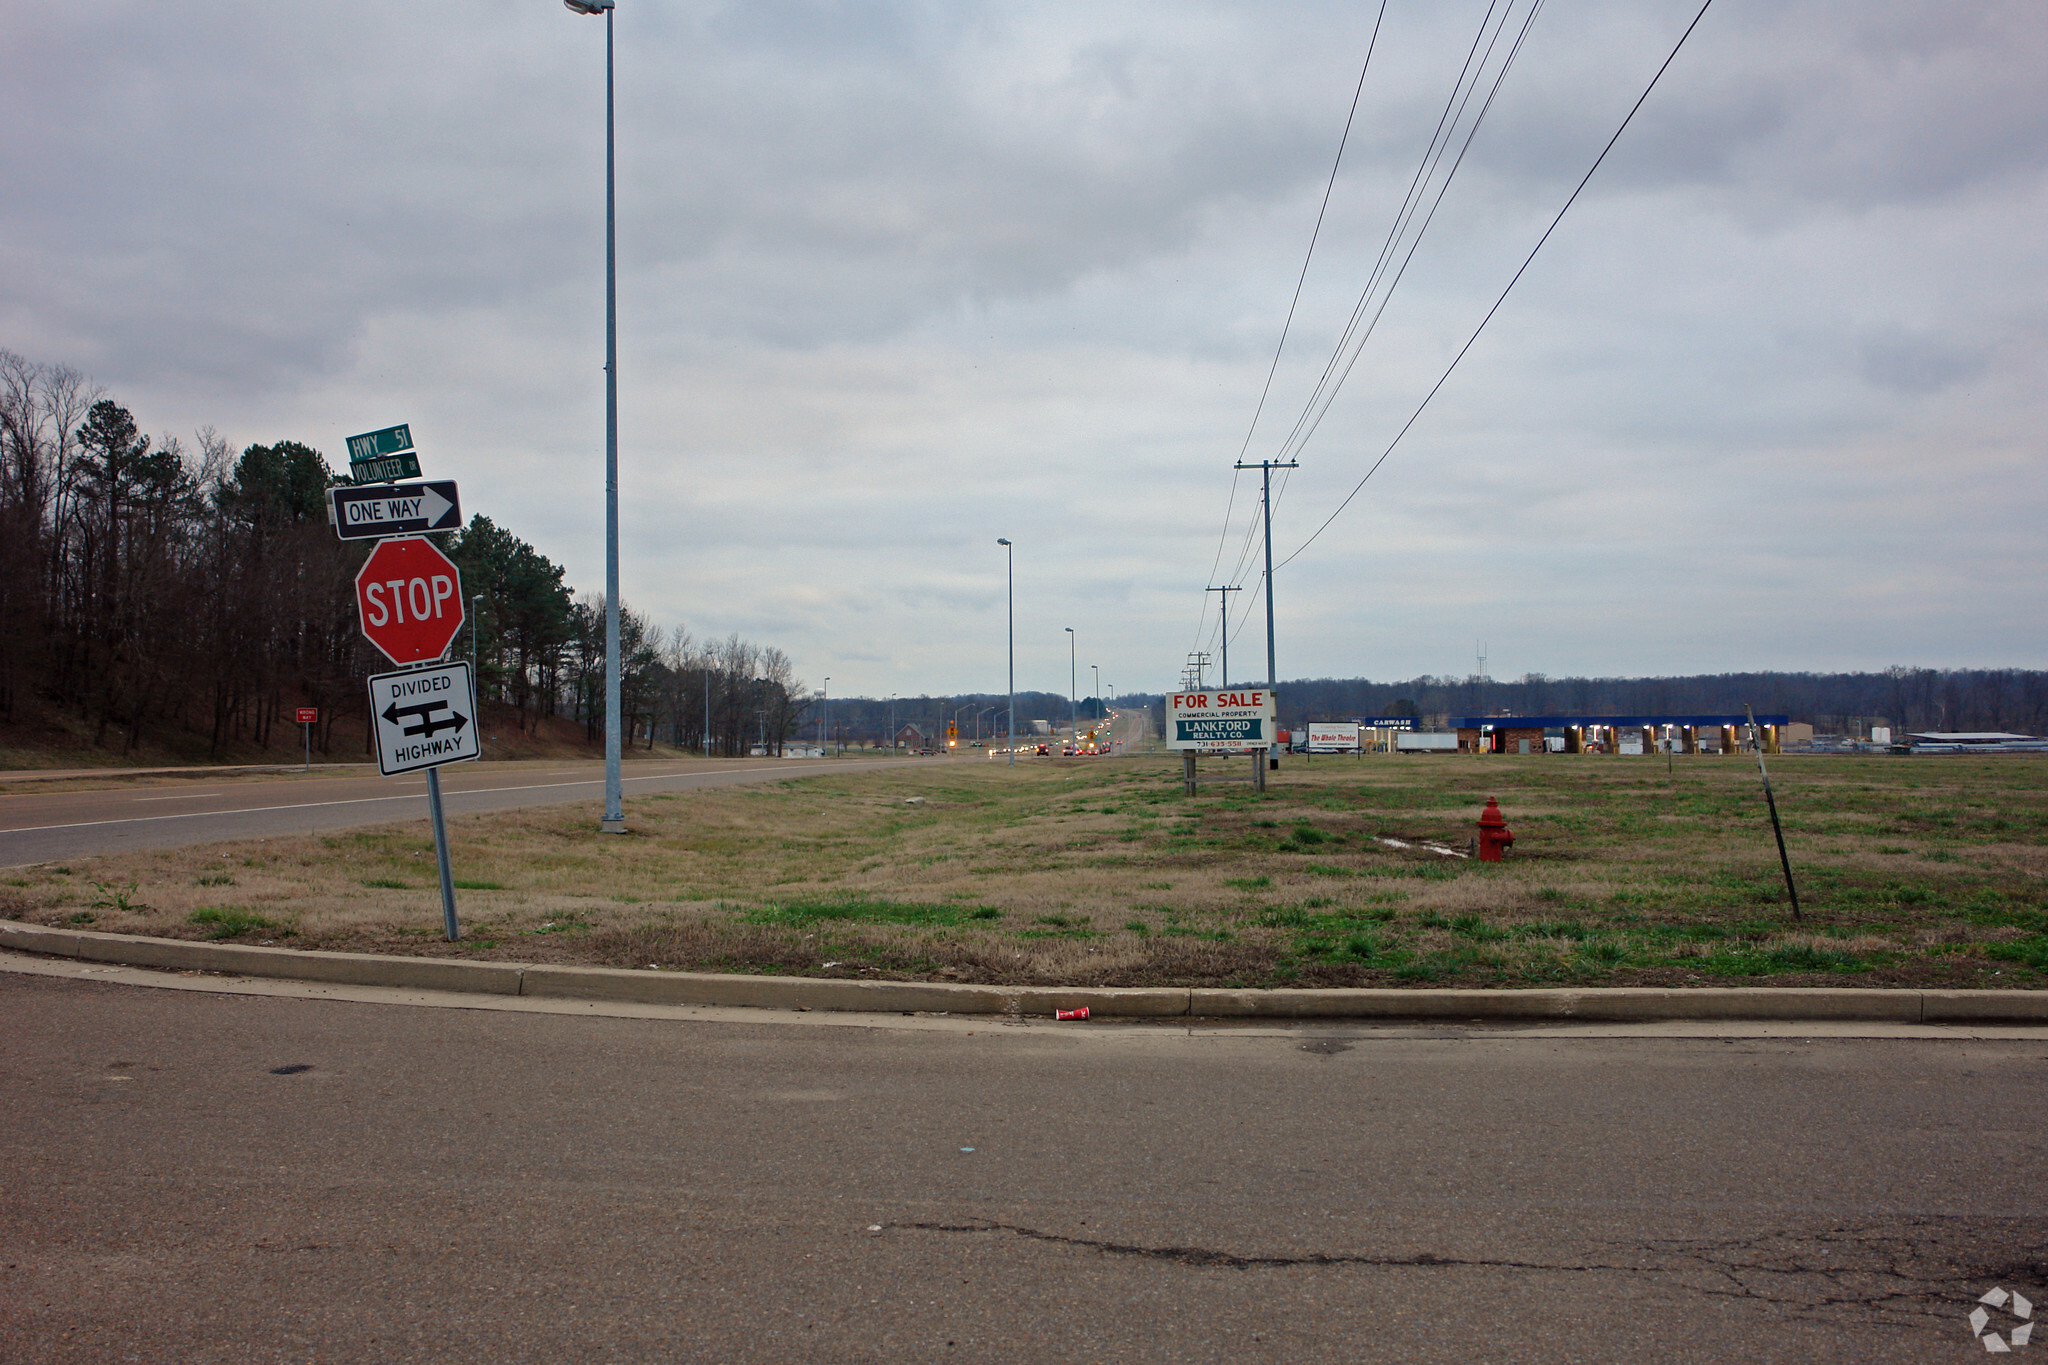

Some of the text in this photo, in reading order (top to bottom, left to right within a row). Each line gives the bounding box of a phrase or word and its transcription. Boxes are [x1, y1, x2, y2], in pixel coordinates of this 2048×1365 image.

[351, 428, 409, 459] HWY 51
[352, 458, 405, 482] VOLUNTEER
[349, 498, 421, 522] ONE WAY
[366, 574, 453, 627] STOP
[391, 675, 451, 699] DIVIDED
[1174, 693, 1262, 708] FOR SALE
[1185, 721, 1250, 731] LANKFORD
[395, 736, 462, 763] HIGHWAY
